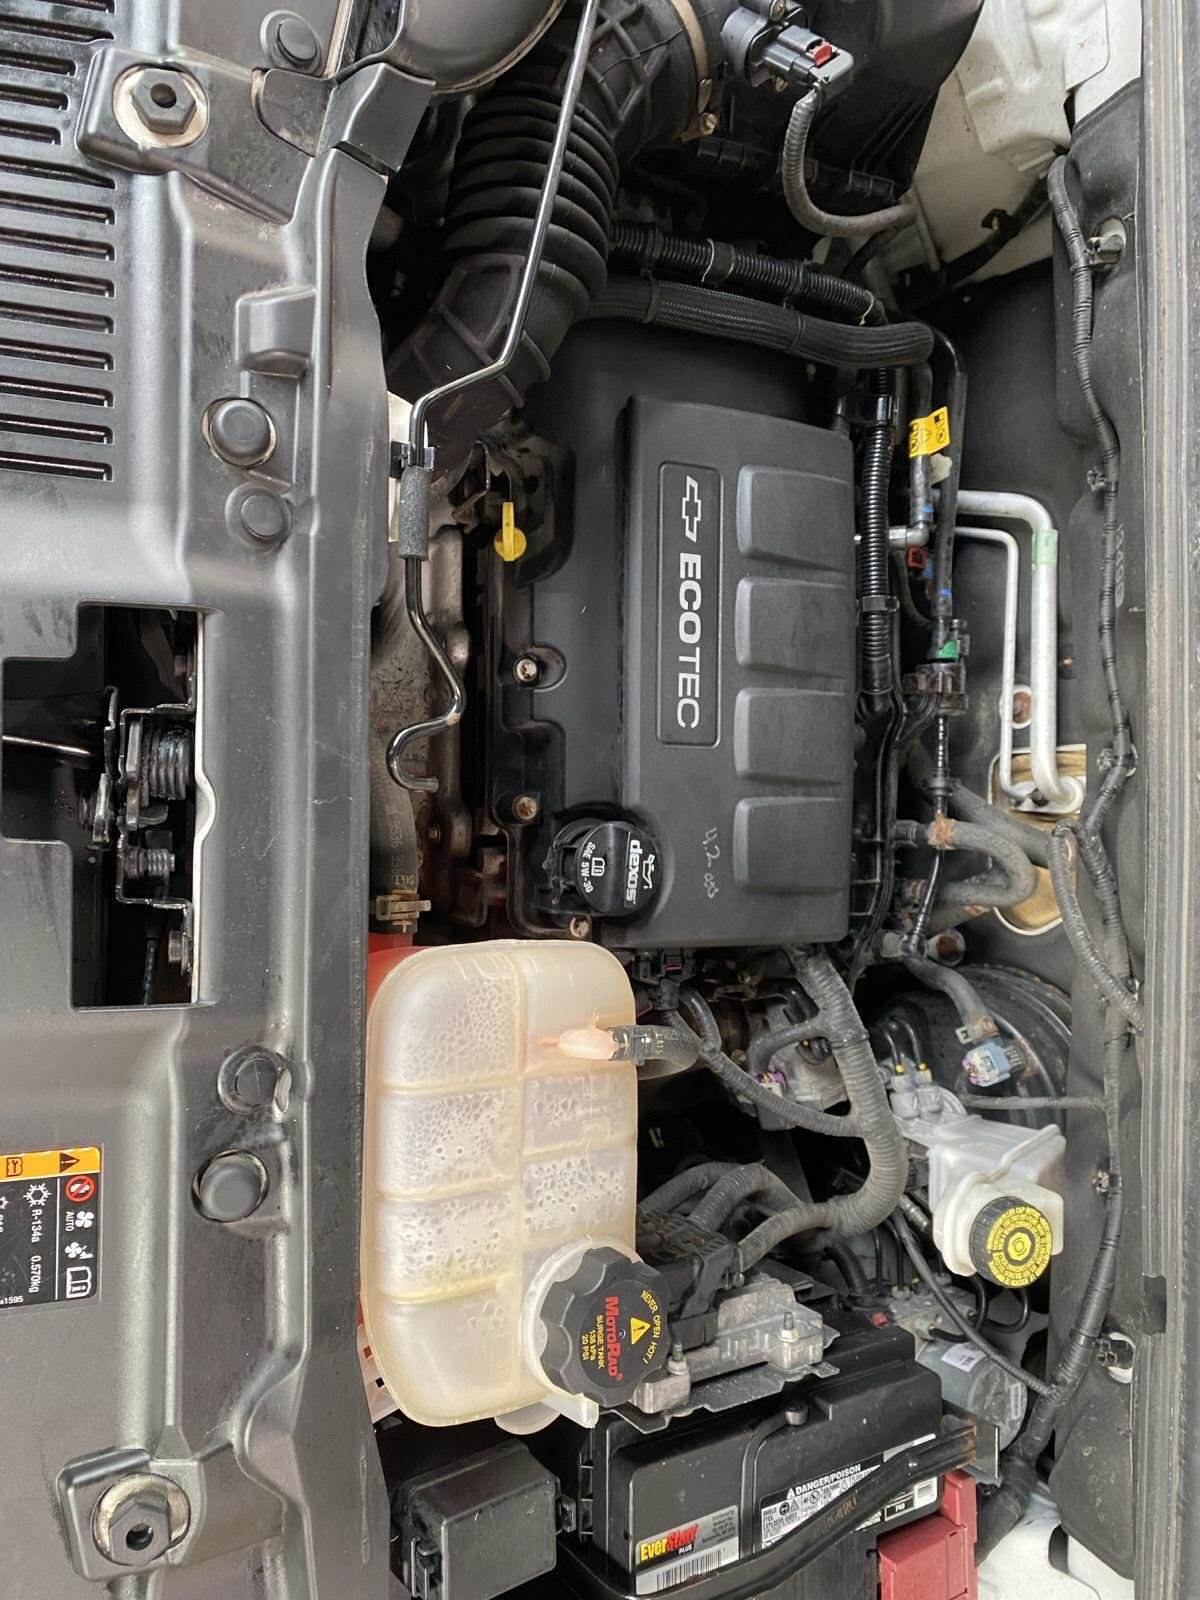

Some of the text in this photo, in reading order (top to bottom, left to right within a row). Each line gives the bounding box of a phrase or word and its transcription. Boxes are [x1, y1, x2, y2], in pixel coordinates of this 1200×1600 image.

[678, 552, 701, 730] ECOTEC
[581, 841, 596, 894] SAE 5W-30
[626, 839, 644, 902] dexos
[64, 1211, 75, 1232] AUTO
[28, 1209, 42, 1293] R-134a 0.570kg
[640, 1290, 658, 1314] NEVER
[652, 1314, 661, 1338] OPEN
[582, 1334, 589, 1345] 20
[596, 1315, 605, 1370] SURGE TANK
[794, 1463, 862, 1494] DANGER/POISON
[640, 1523, 699, 1562] EverStart
[678, 1544, 693, 1555] PLUS
